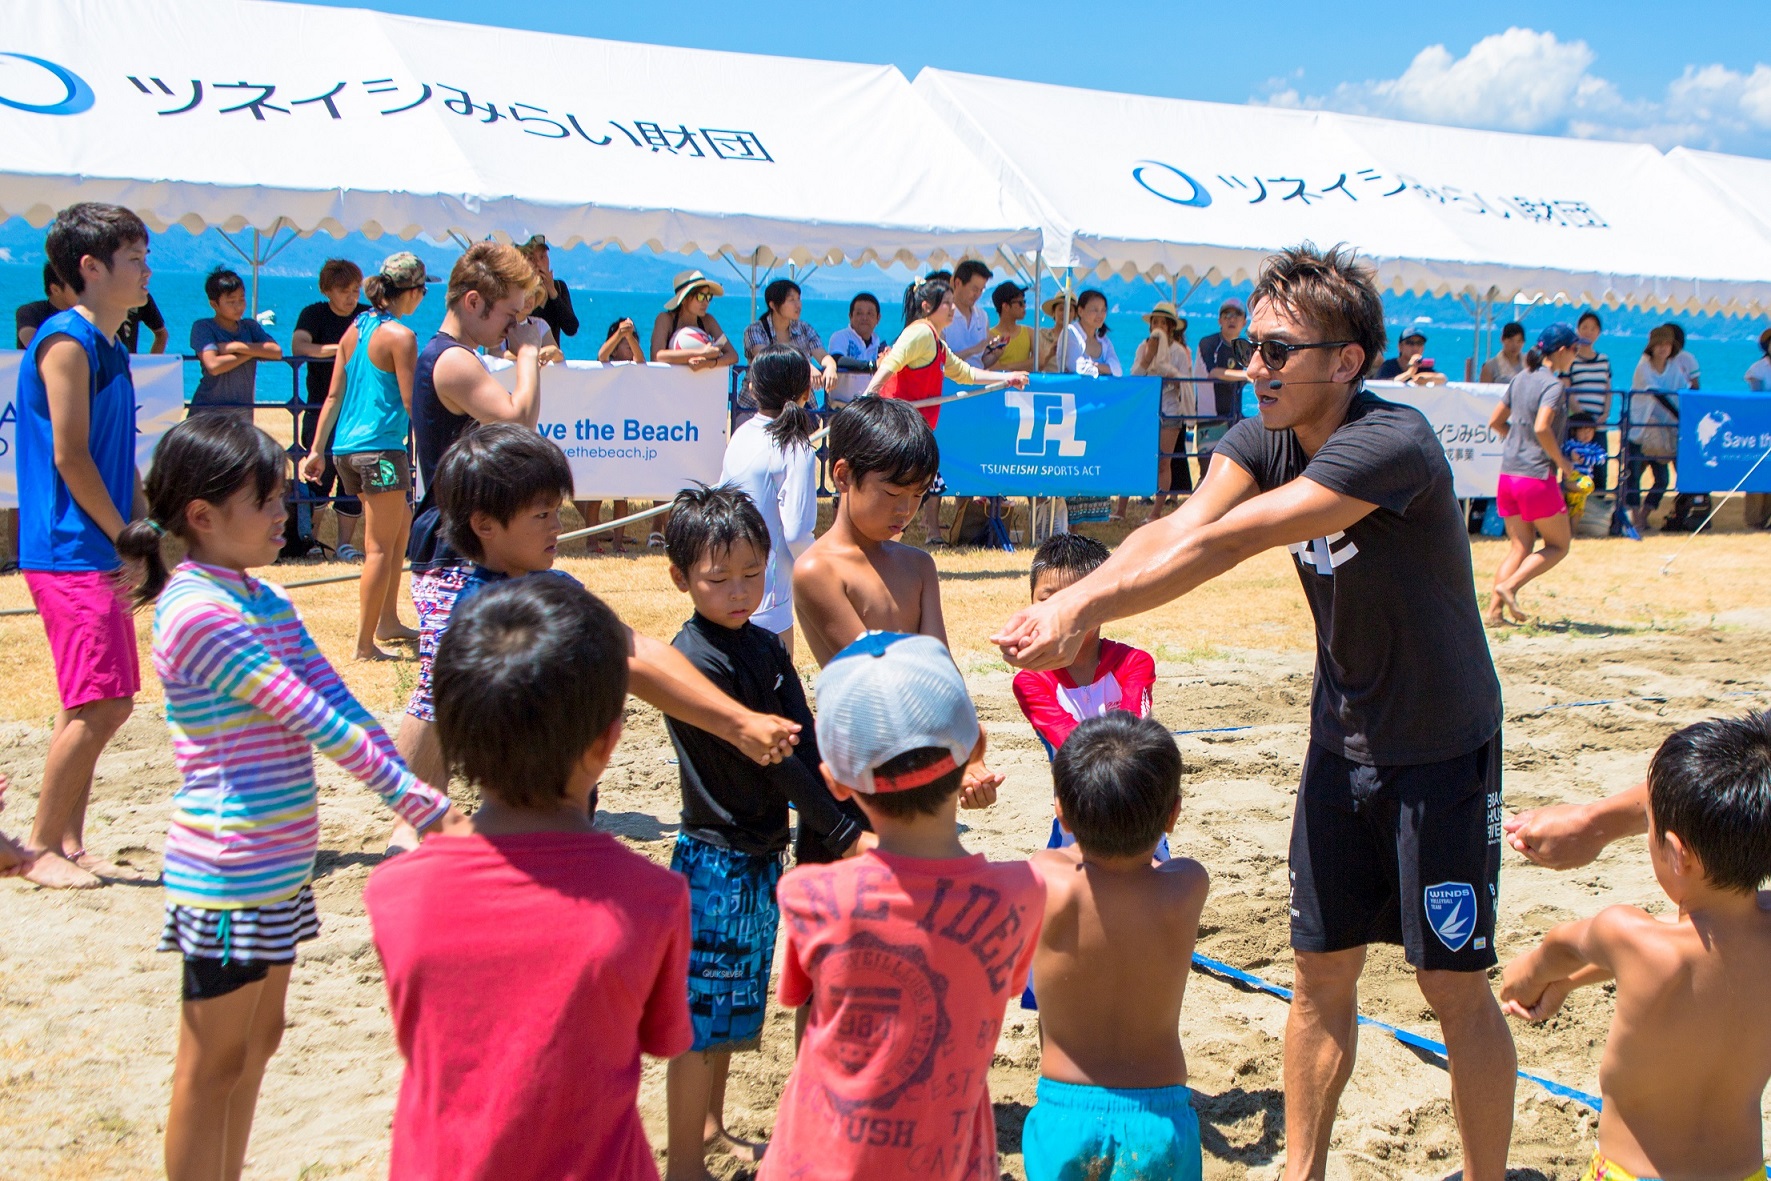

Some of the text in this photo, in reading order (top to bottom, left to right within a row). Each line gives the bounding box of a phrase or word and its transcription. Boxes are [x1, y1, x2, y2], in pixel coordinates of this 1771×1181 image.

[126, 76, 776, 163] ツネイシみらい財団
[1217, 168, 1610, 229] ツネイシみらい財団
[538, 418, 699, 442] ve the Beach
[1722, 430, 1757, 449] Save
[980, 463, 1101, 477] TSUNEISHI SPORTS ACT
[1429, 889, 1470, 898] WINDS
[702, 969, 743, 978] QUIKSILVER
